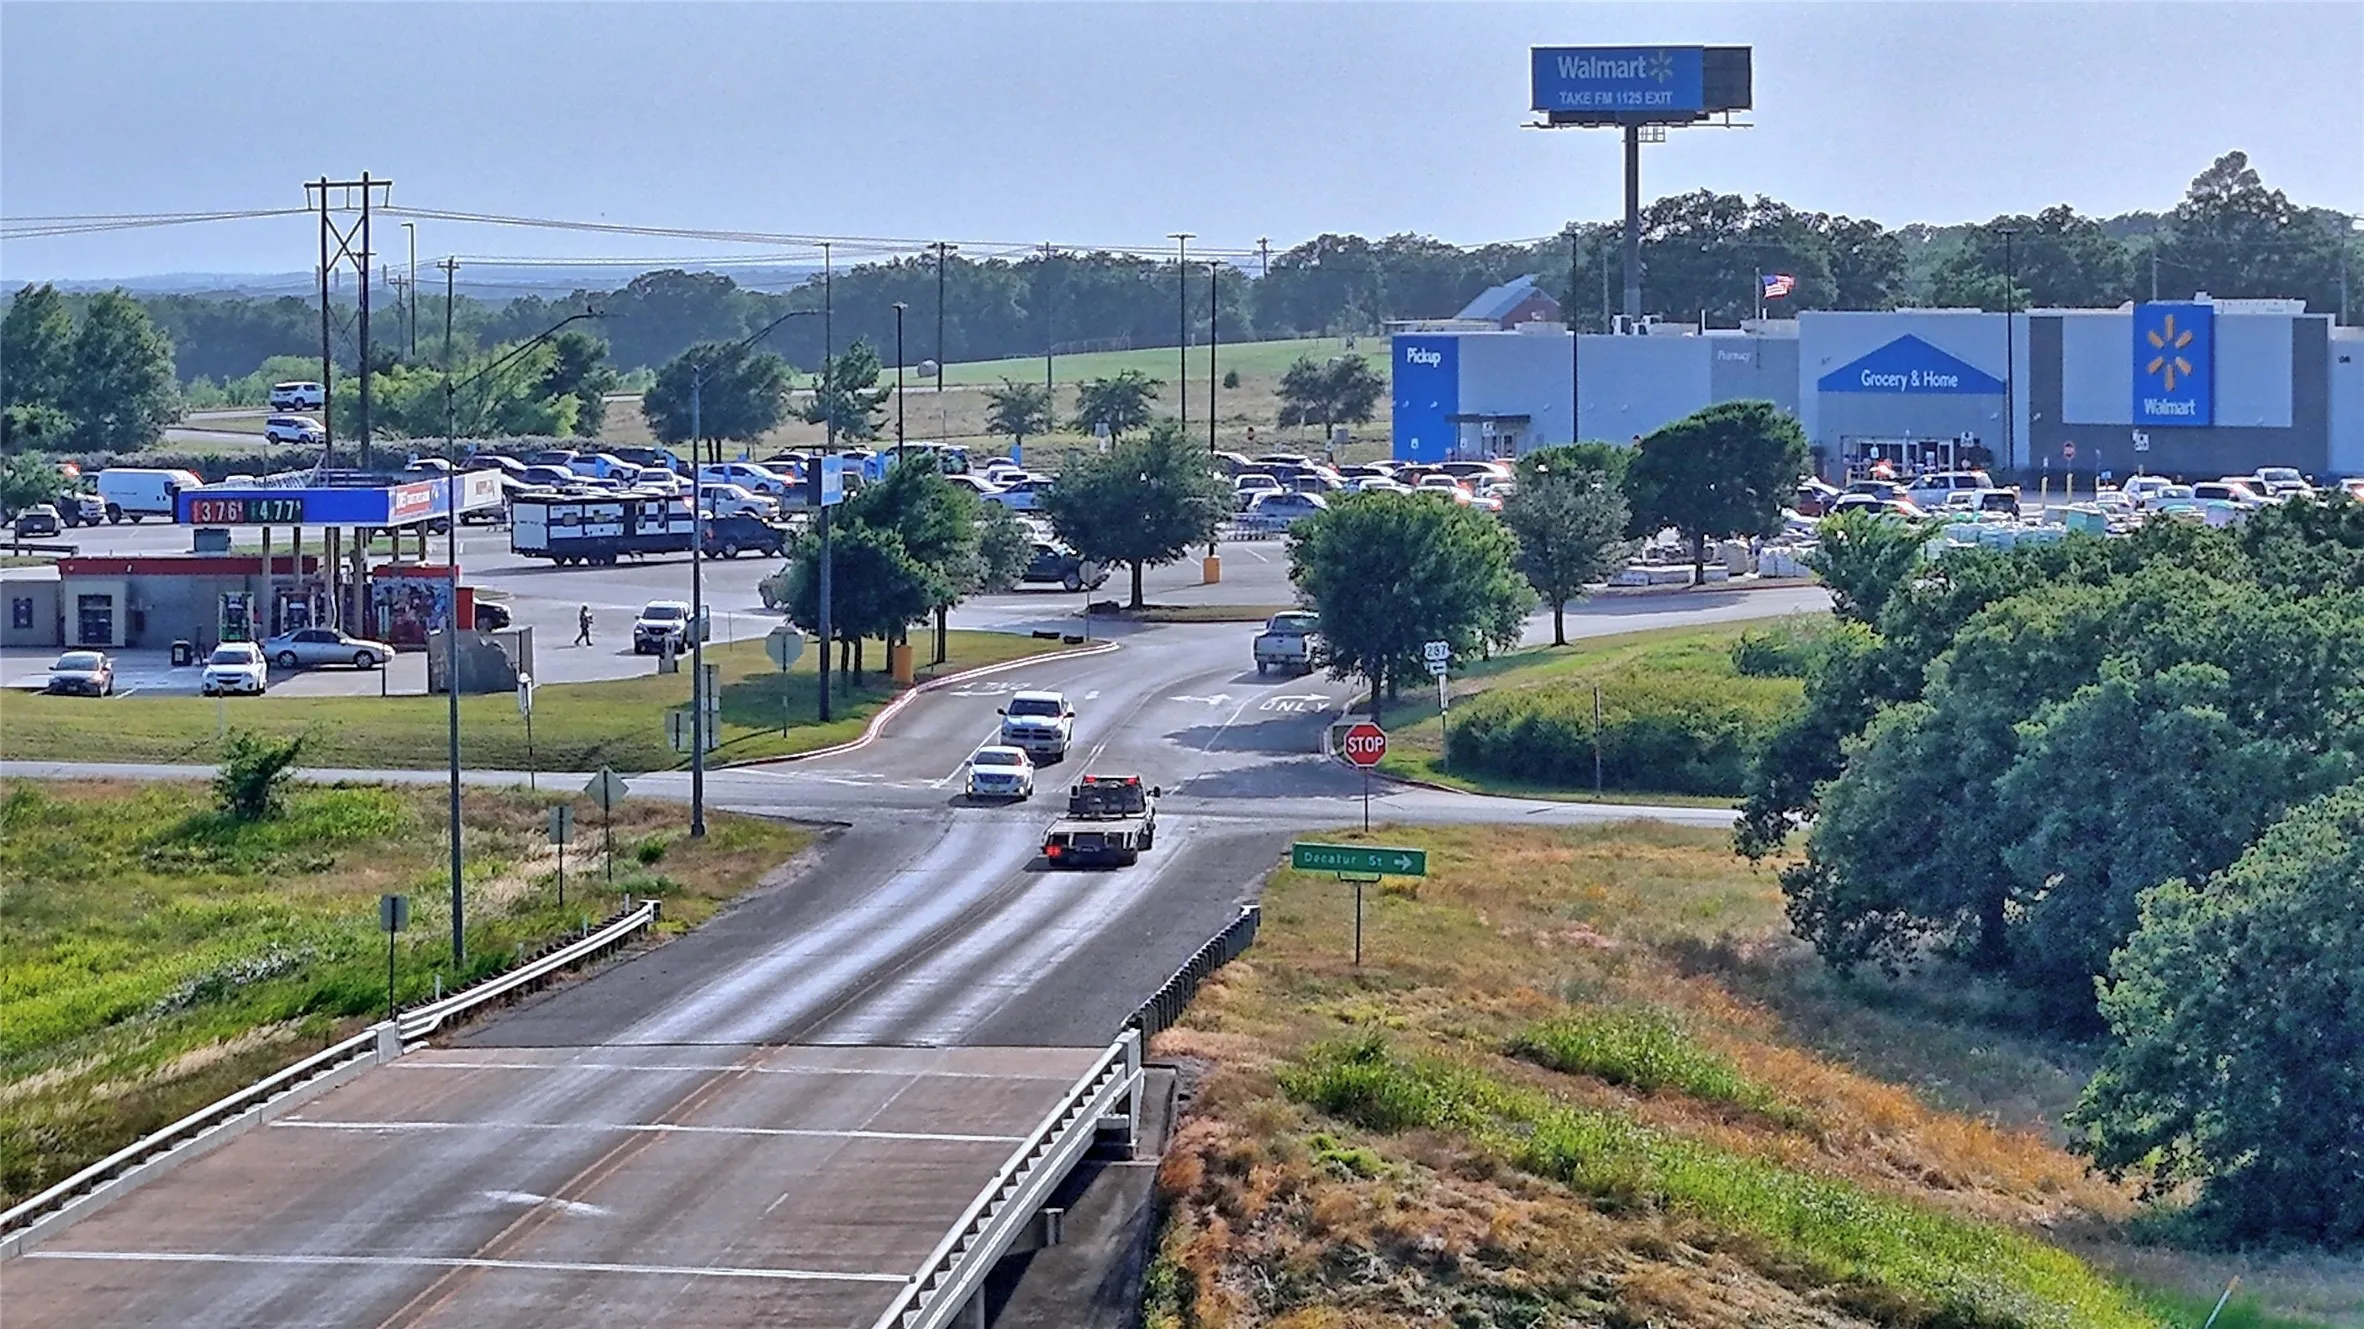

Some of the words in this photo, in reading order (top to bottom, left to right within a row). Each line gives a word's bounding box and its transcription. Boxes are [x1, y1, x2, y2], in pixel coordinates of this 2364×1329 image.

[1557, 54, 1647, 79] Walmart
[1559, 91, 1591, 105] TAKE
[1594, 91, 1613, 105] FM
[1616, 91, 1643, 105] 1125
[1645, 91, 1673, 105] EXIT
[1406, 346, 1441, 368] Pickup
[1861, 368, 1907, 392] Grocery
[1910, 369, 1921, 387] &
[1923, 370, 1958, 388] Home
[2143, 397, 2196, 416] Walmart
[1427, 645, 1446, 656] 287
[1259, 700, 1331, 713] ONLY
[1347, 735, 1384, 753] STOP
[1303, 852, 1357, 865] Decatur
[1368, 854, 1383, 867] St
